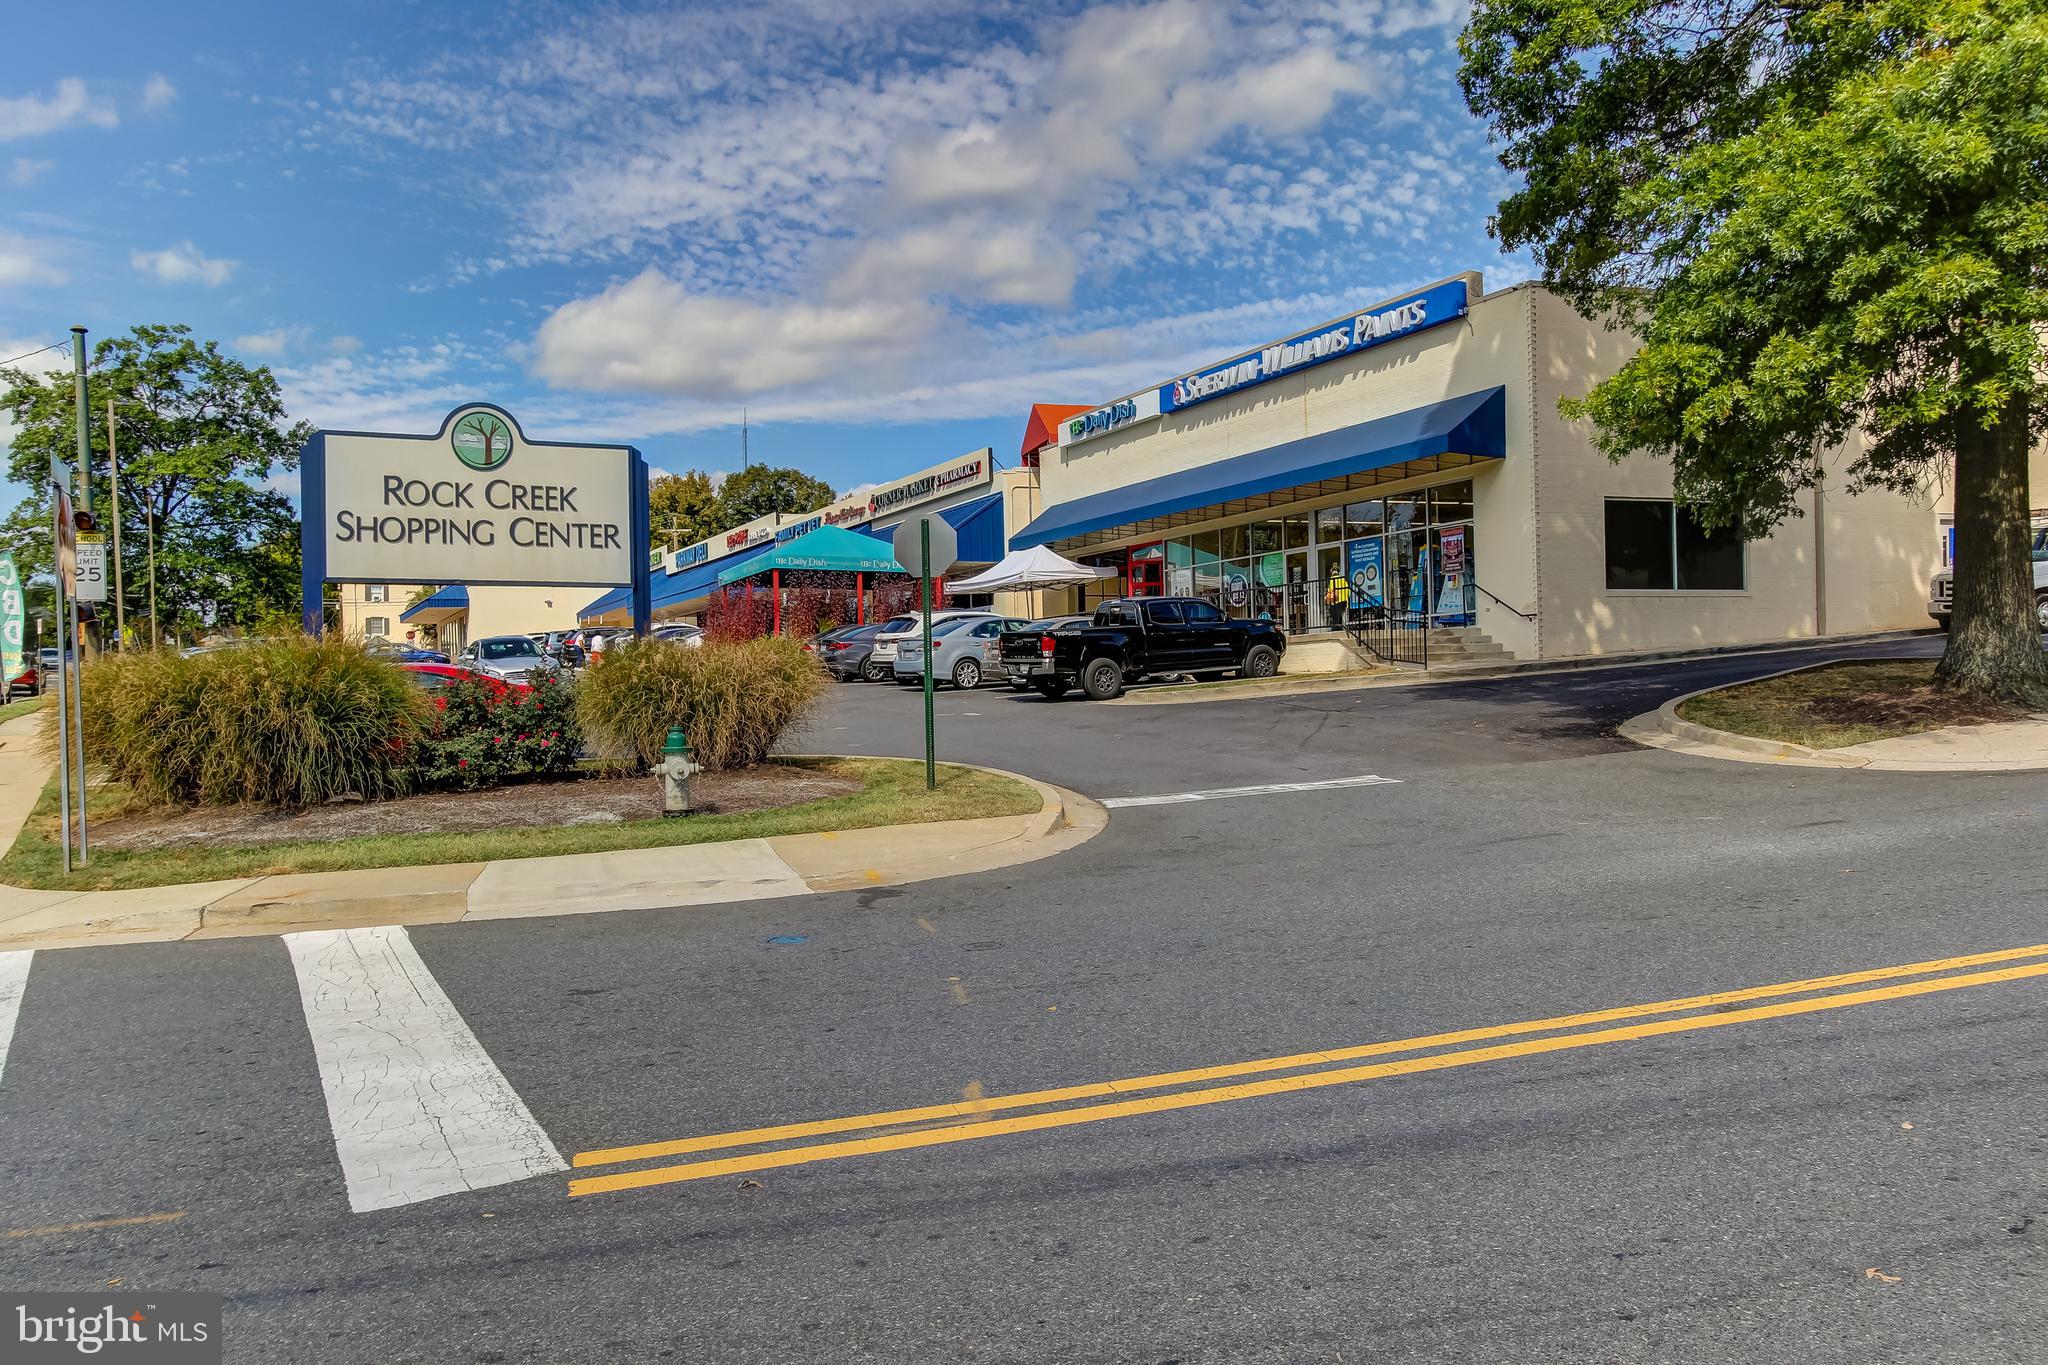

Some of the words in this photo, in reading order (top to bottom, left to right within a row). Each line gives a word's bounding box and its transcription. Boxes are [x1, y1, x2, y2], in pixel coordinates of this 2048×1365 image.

[1184, 326, 1350, 398] SHERWIN-WILLIAMS
[1353, 300, 1427, 344] PAINTS
[1084, 410, 1111, 433] Daily
[1111, 399, 1137, 423] Dish
[940, 460, 979, 483] PHARMACY
[383, 475, 474, 509] ROCK
[485, 479, 578, 512] CREEK
[76, 535, 103, 543] CHOOL
[335, 510, 495, 546] SHOPPING
[509, 516, 622, 550] CENTER
[77, 549, 102, 557] PEED
[788, 556, 806, 567] Daily
[808, 557, 827, 567] Dish
[75, 567, 101, 582] 25
